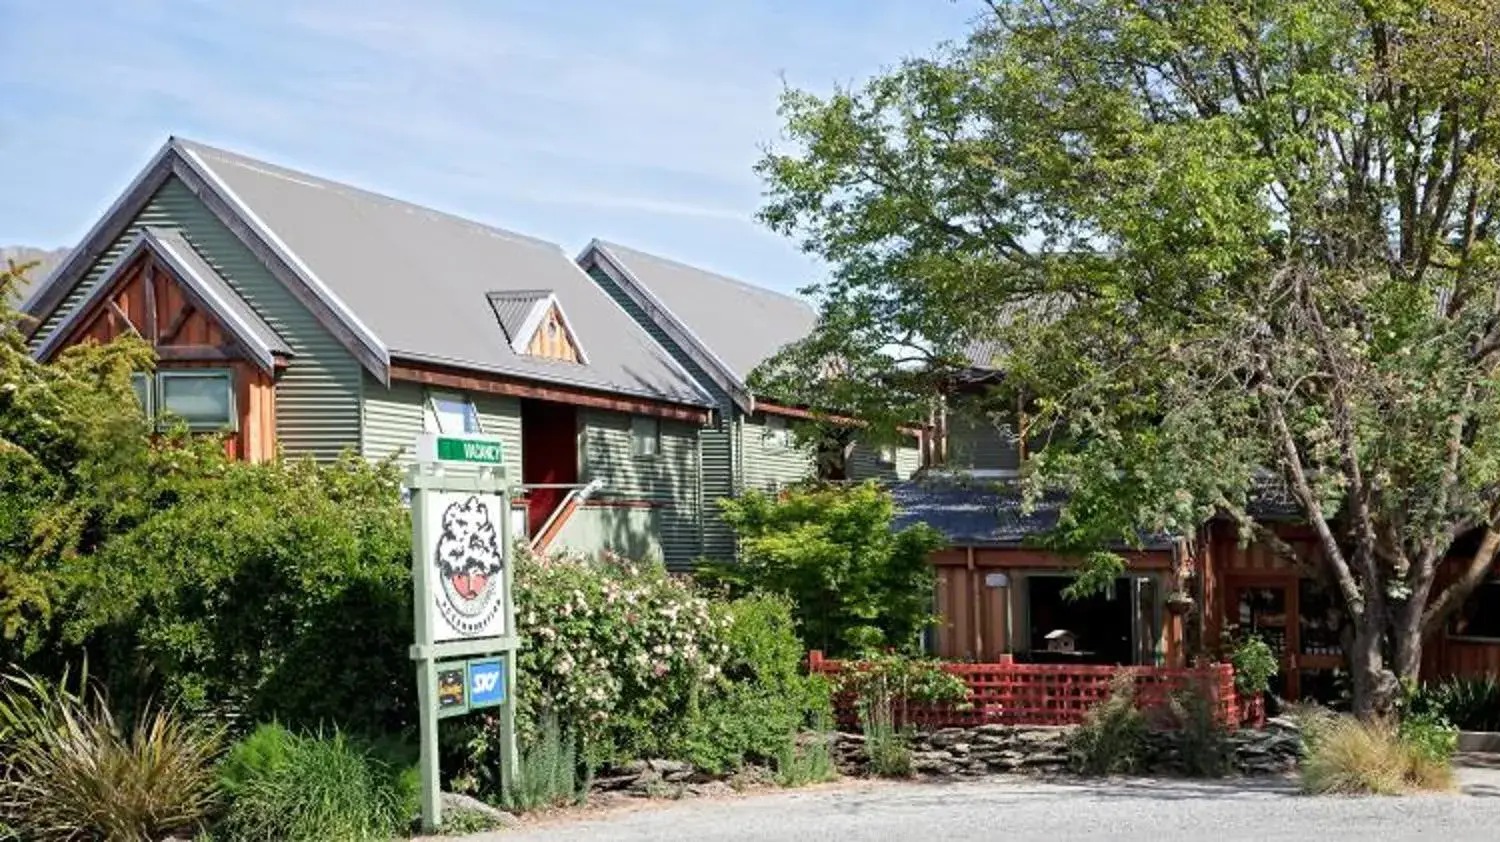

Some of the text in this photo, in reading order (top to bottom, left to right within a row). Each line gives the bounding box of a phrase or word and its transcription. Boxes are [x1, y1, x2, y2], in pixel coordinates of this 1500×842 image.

[463, 442, 501, 460] VACANCY
[442, 597, 501, 631] ACCOMMODATION
[472, 671, 500, 694] SKY
